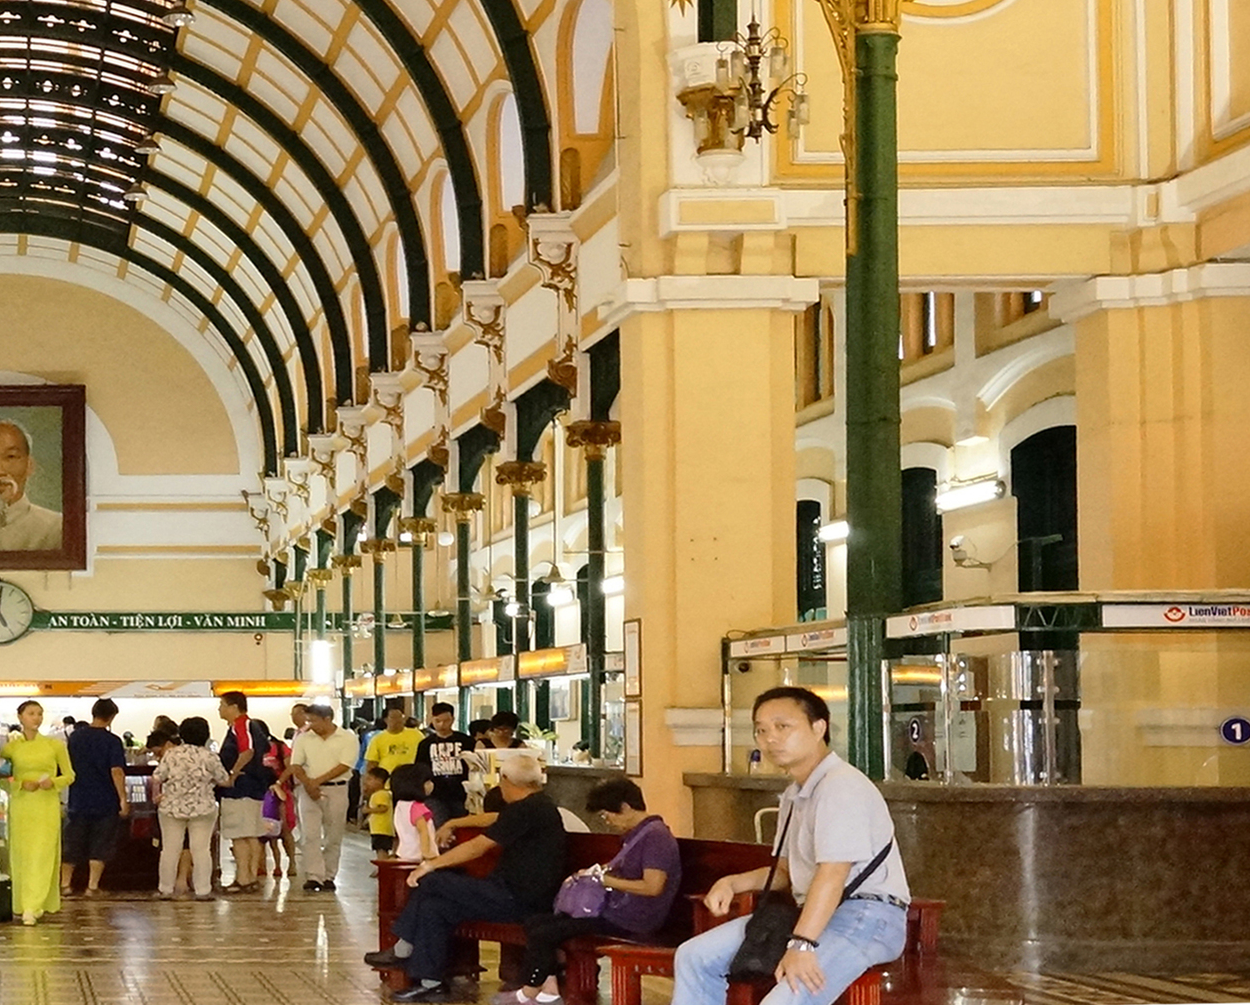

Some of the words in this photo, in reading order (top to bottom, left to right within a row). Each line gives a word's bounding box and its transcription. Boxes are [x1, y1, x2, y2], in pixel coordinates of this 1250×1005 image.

[49, 615, 68, 627] AN
[70, 612, 110, 627] TOÀN
[119, 612, 154, 628] TIỆN
[157, 614, 183, 629] LỢI
[193, 612, 223, 627] VĂN
[226, 615, 266, 627] MINH
[912, 722, 918, 739] 2
[1231, 722, 1242, 740] 1
